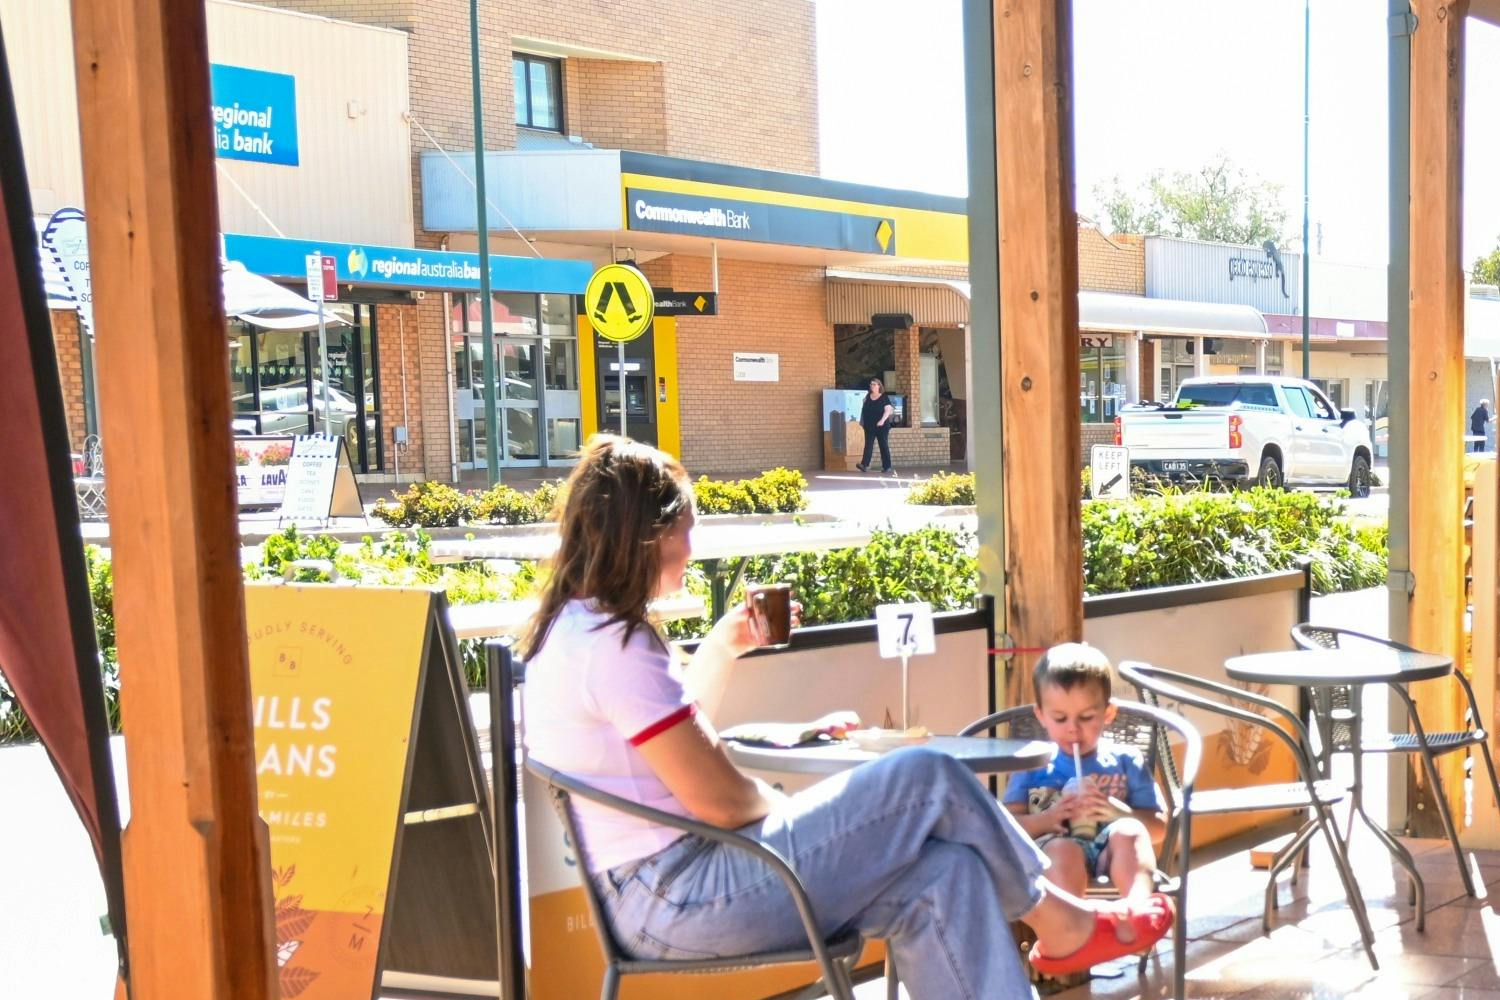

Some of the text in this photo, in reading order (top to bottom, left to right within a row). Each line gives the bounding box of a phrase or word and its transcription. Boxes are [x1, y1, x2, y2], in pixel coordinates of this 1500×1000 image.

[212, 102, 272, 129] egional
[214, 126, 273, 154] lia bank
[73, 260, 90, 271] COF
[1080, 337, 1109, 348] RY
[1099, 451, 1123, 460] KEEP
[1099, 461, 1121, 471] LEFT
[261, 469, 288, 486] LAVA
[897, 613, 914, 645] 7
[248, 620, 353, 666] UDLY SERVING
[254, 695, 333, 731] ILLS
[256, 742, 337, 779] ANS
[268, 811, 328, 828] MILES
